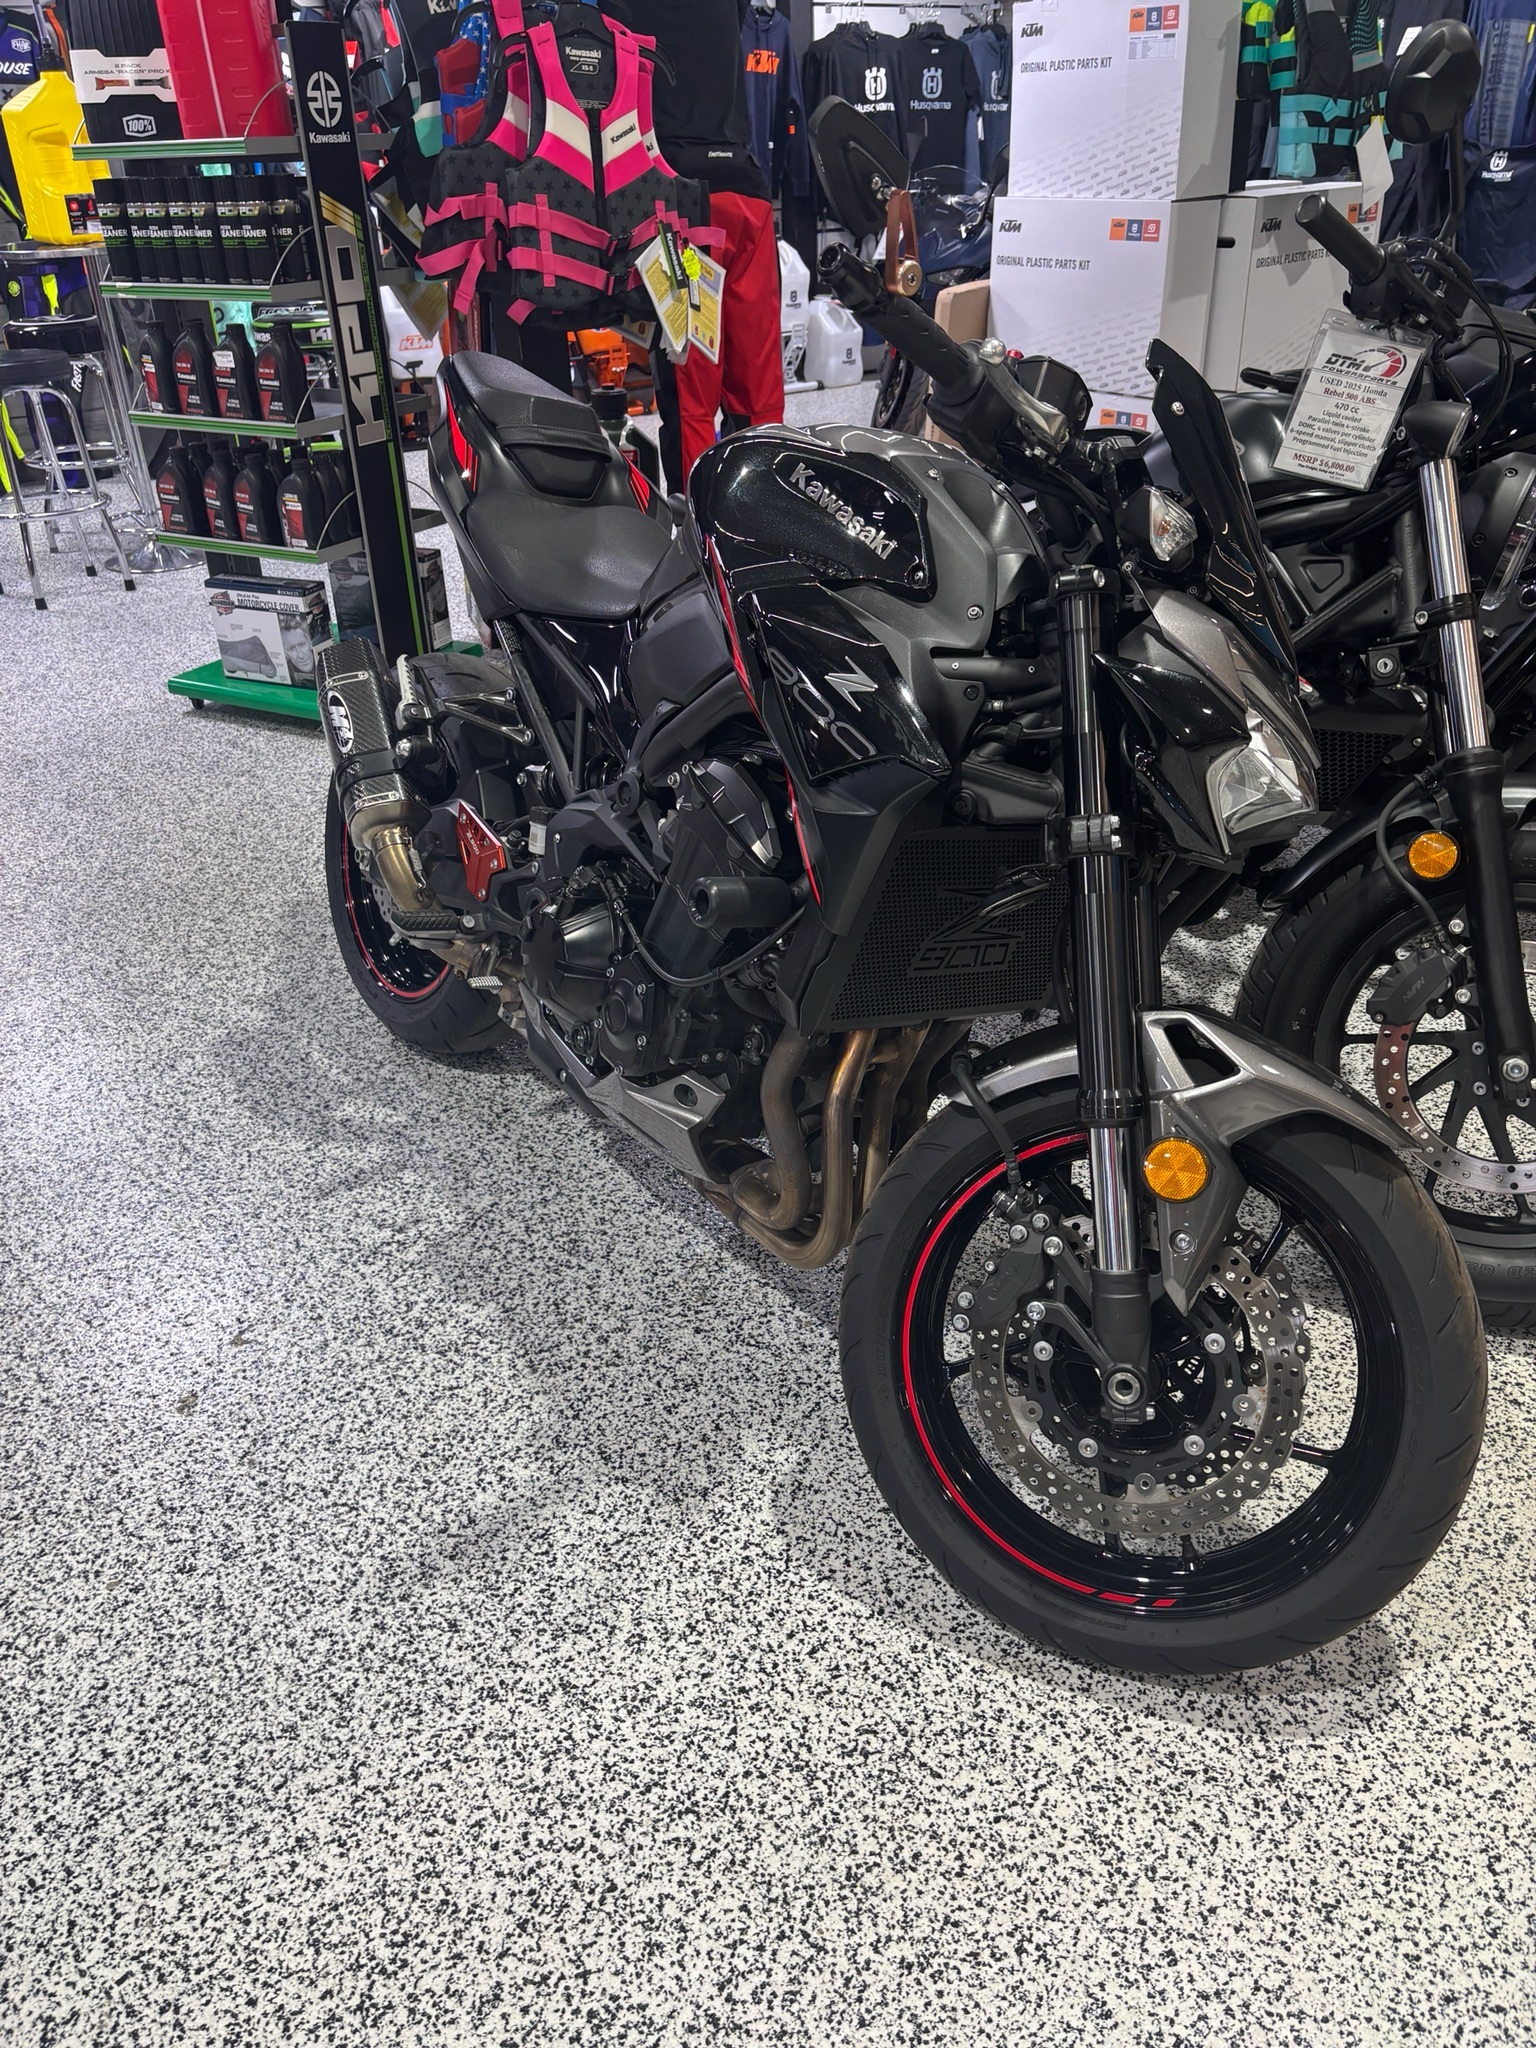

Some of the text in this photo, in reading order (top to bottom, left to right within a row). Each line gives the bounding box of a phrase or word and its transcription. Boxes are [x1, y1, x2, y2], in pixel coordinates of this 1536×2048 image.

[1021, 22, 1043, 38] KTM
[565, 46, 601, 59] Kawasaki
[1021, 56, 1112, 74] ORIGINAL PLASTIC PARTS KIT
[910, 99, 952, 111] Husqvarna
[127, 119, 152, 132] 100%
[610, 123, 637, 144] Kawasaki
[309, 131, 351, 143] Kawasaki
[999, 219, 1022, 233] KTM
[1260, 217, 1282, 233] KTM
[360, 245, 369, 279] OILS
[665, 232, 684, 281] Kawasaki
[996, 255, 1091, 271] ORIGINAL PLASTIC PARTS KIT
[1256, 257, 1284, 269] ORIGINAL
[1284, 253, 1307, 265] PLASTIC
[1307, 249, 1325, 260] PARTS
[325, 226, 387, 447] KPO
[362, 281, 383, 377] PERFORMANCE
[1324, 353, 1366, 371] DTM
[1321, 365, 1399, 386] POWERSPORTS
[1320, 375, 1388, 398] USED 2025 Honda
[1323, 387, 1376, 405] Rebel 500 ABS
[1322, 410, 1362, 424] Liquid cooled
[1334, 402, 1360, 414] 470 cc
[1298, 421, 1316, 431] DOHC,
[1322, 427, 1340, 436] valves
[1352, 433, 1376, 444] cylinder
[1307, 415, 1370, 434] Parallel-twin 4-stroke
[1289, 428, 1376, 452] 6-speed manual, slipper clutch
[1292, 436, 1368, 459] Programmed Fuel Injection
[1293, 453, 1318, 465] MSRP
[789, 462, 899, 560] Kawasaki
[237, 598, 300, 612] MOTORCYCLE COVER
[913, 942, 1011, 971] 900
